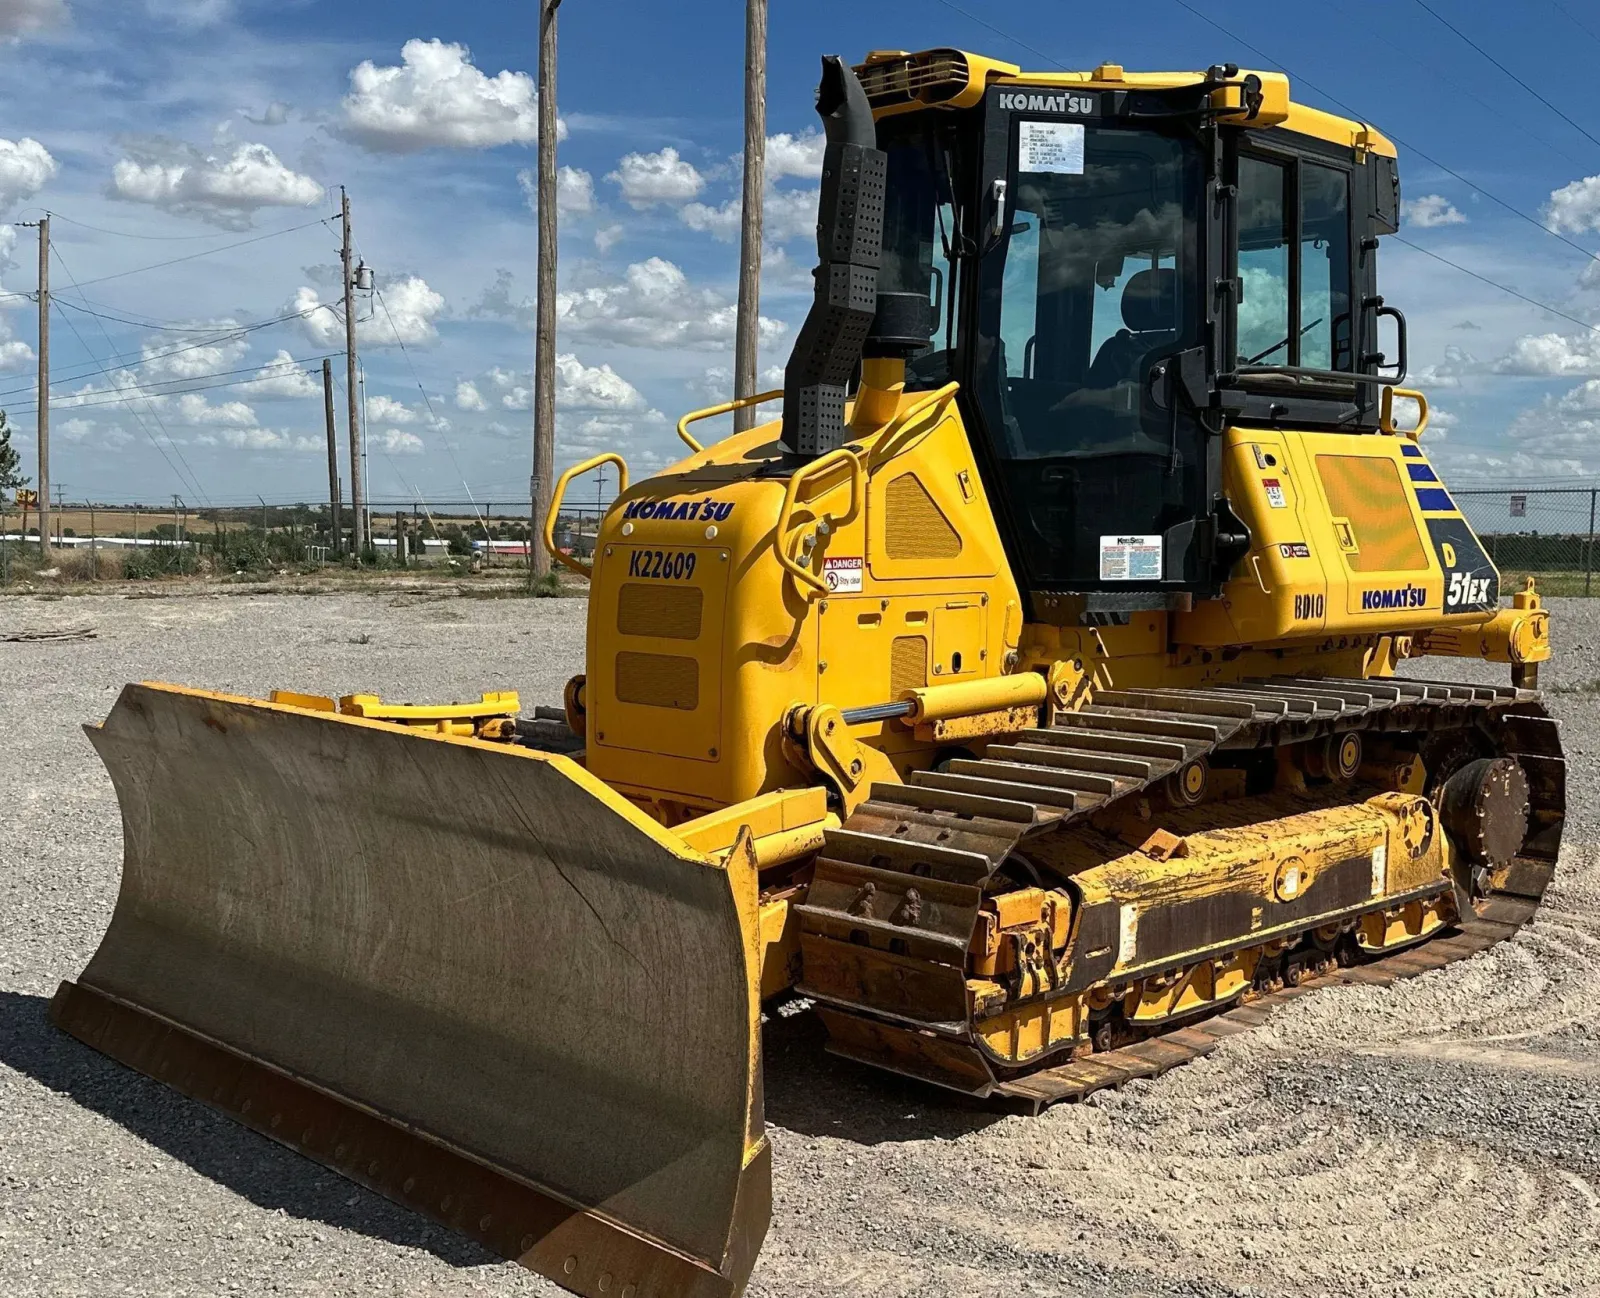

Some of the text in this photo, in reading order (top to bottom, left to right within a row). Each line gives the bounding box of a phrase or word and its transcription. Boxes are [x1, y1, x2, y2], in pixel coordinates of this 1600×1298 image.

[1000, 93, 1093, 114] KOMATSU
[622, 497, 736, 521] KOMATSU
[628, 550, 697, 580] K22609
[832, 558, 863, 569] DANGER
[840, 576, 861, 586] Stay clear
[1447, 572, 1491, 606] 51EX
[1362, 583, 1427, 609] KOMATSU
